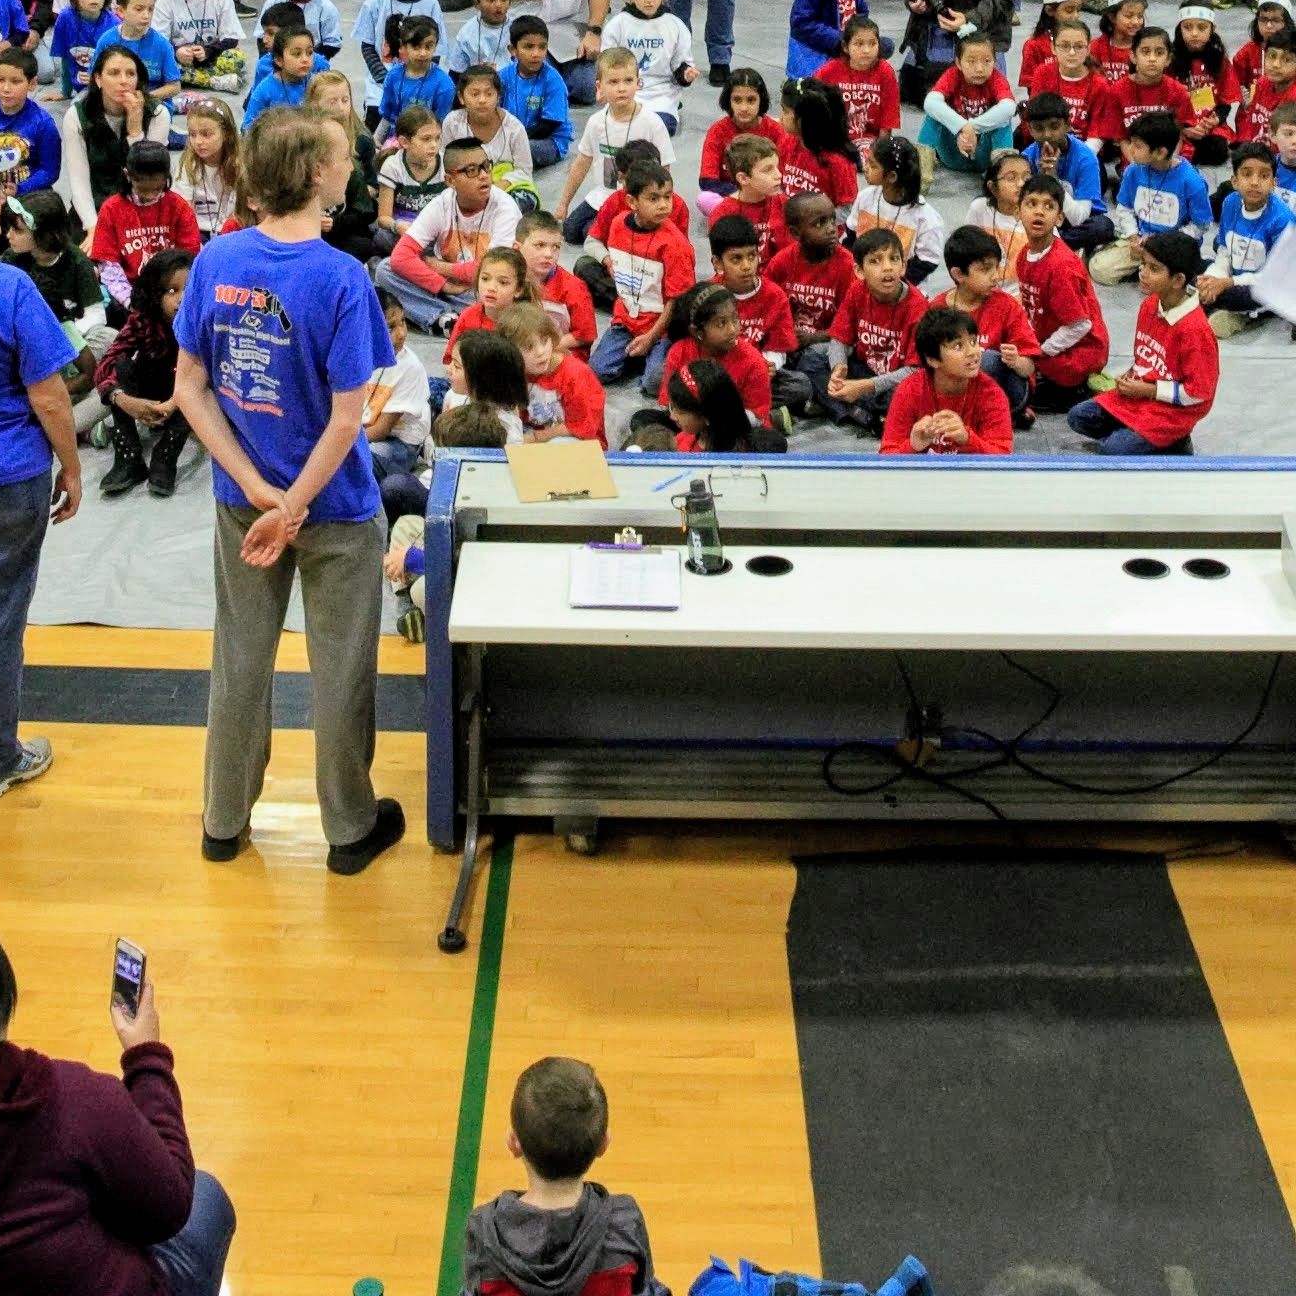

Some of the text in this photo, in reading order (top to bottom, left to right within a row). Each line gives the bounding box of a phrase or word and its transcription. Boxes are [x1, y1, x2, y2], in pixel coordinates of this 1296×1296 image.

[176, 19, 216, 31] WATER
[627, 38, 664, 49] WATER
[215, 284, 266, 308] 1073
